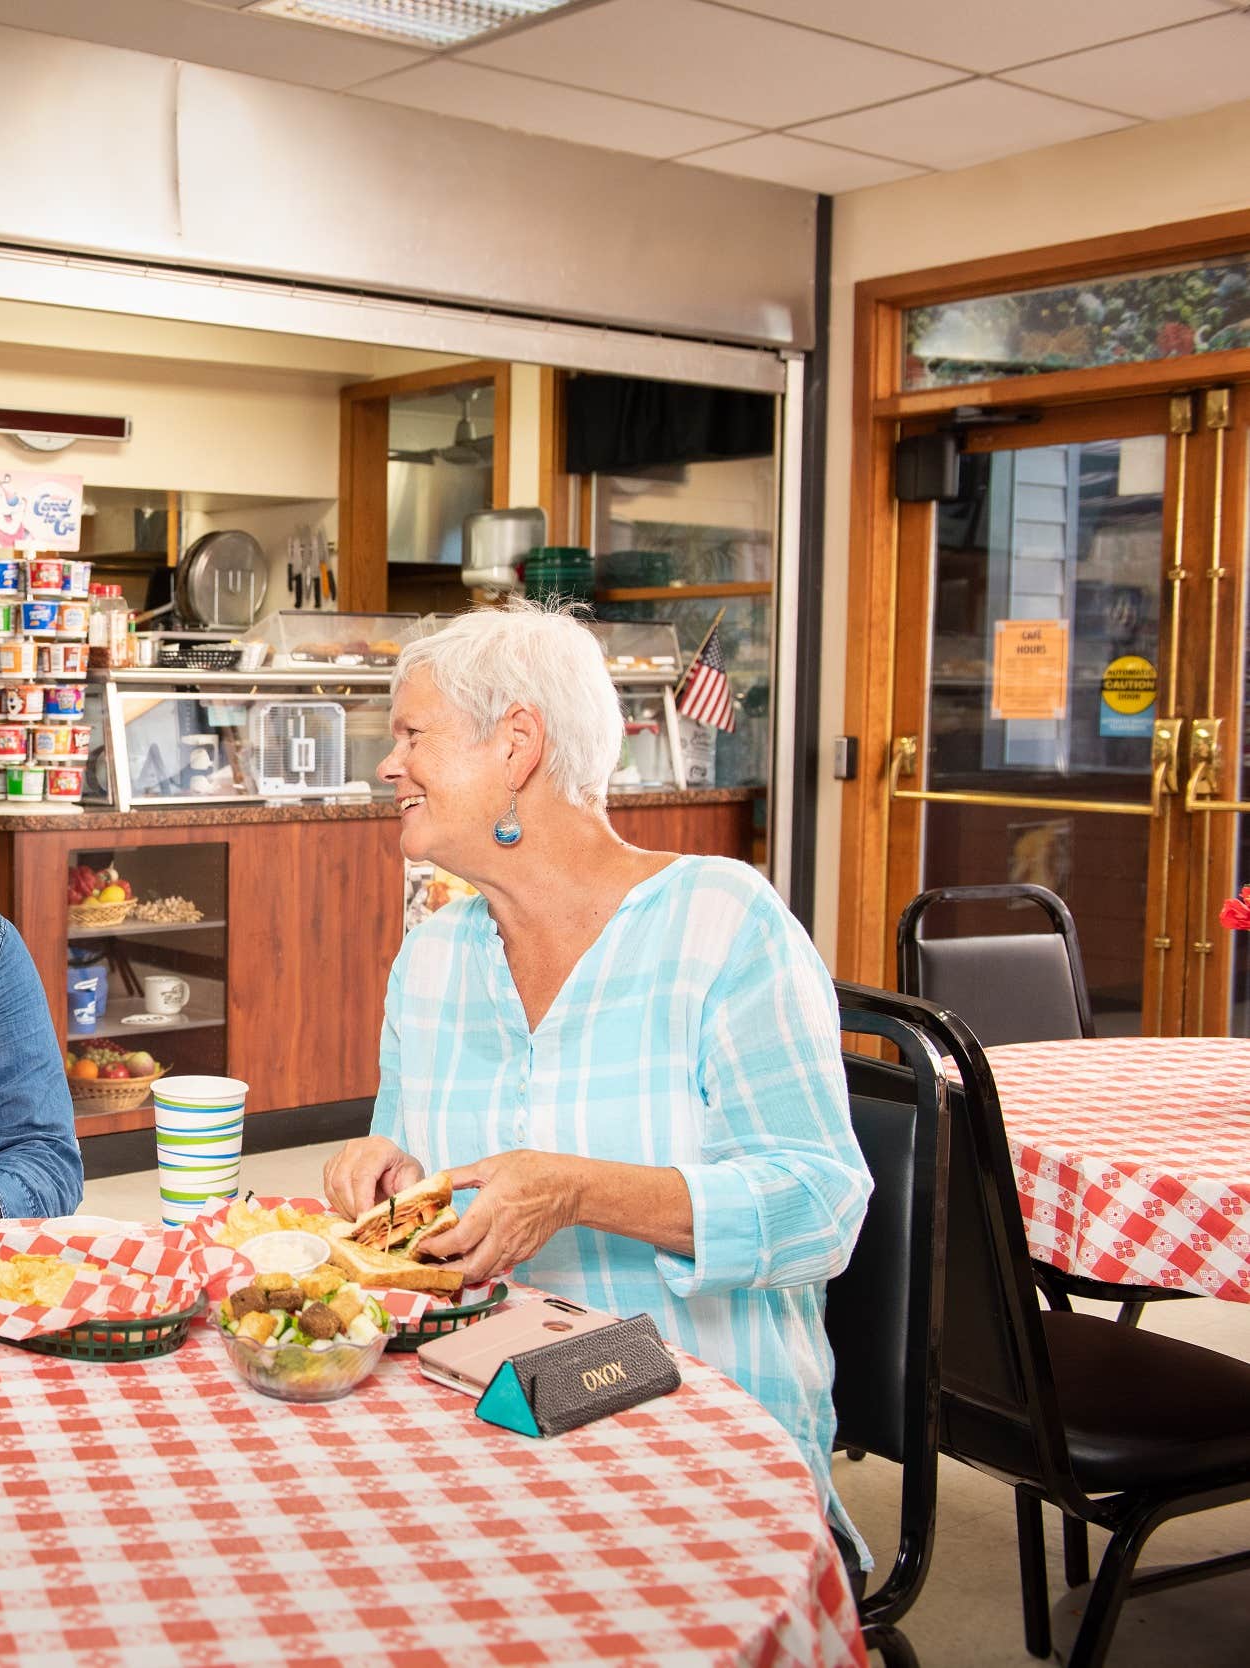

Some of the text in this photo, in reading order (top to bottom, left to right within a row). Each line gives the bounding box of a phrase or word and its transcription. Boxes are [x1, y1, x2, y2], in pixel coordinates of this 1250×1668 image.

[33, 494, 72, 517] Cereal
[1016, 644, 1047, 655] HOURS
[1105, 680, 1155, 690] CAUTION
[1117, 693, 1141, 701] DOOR
